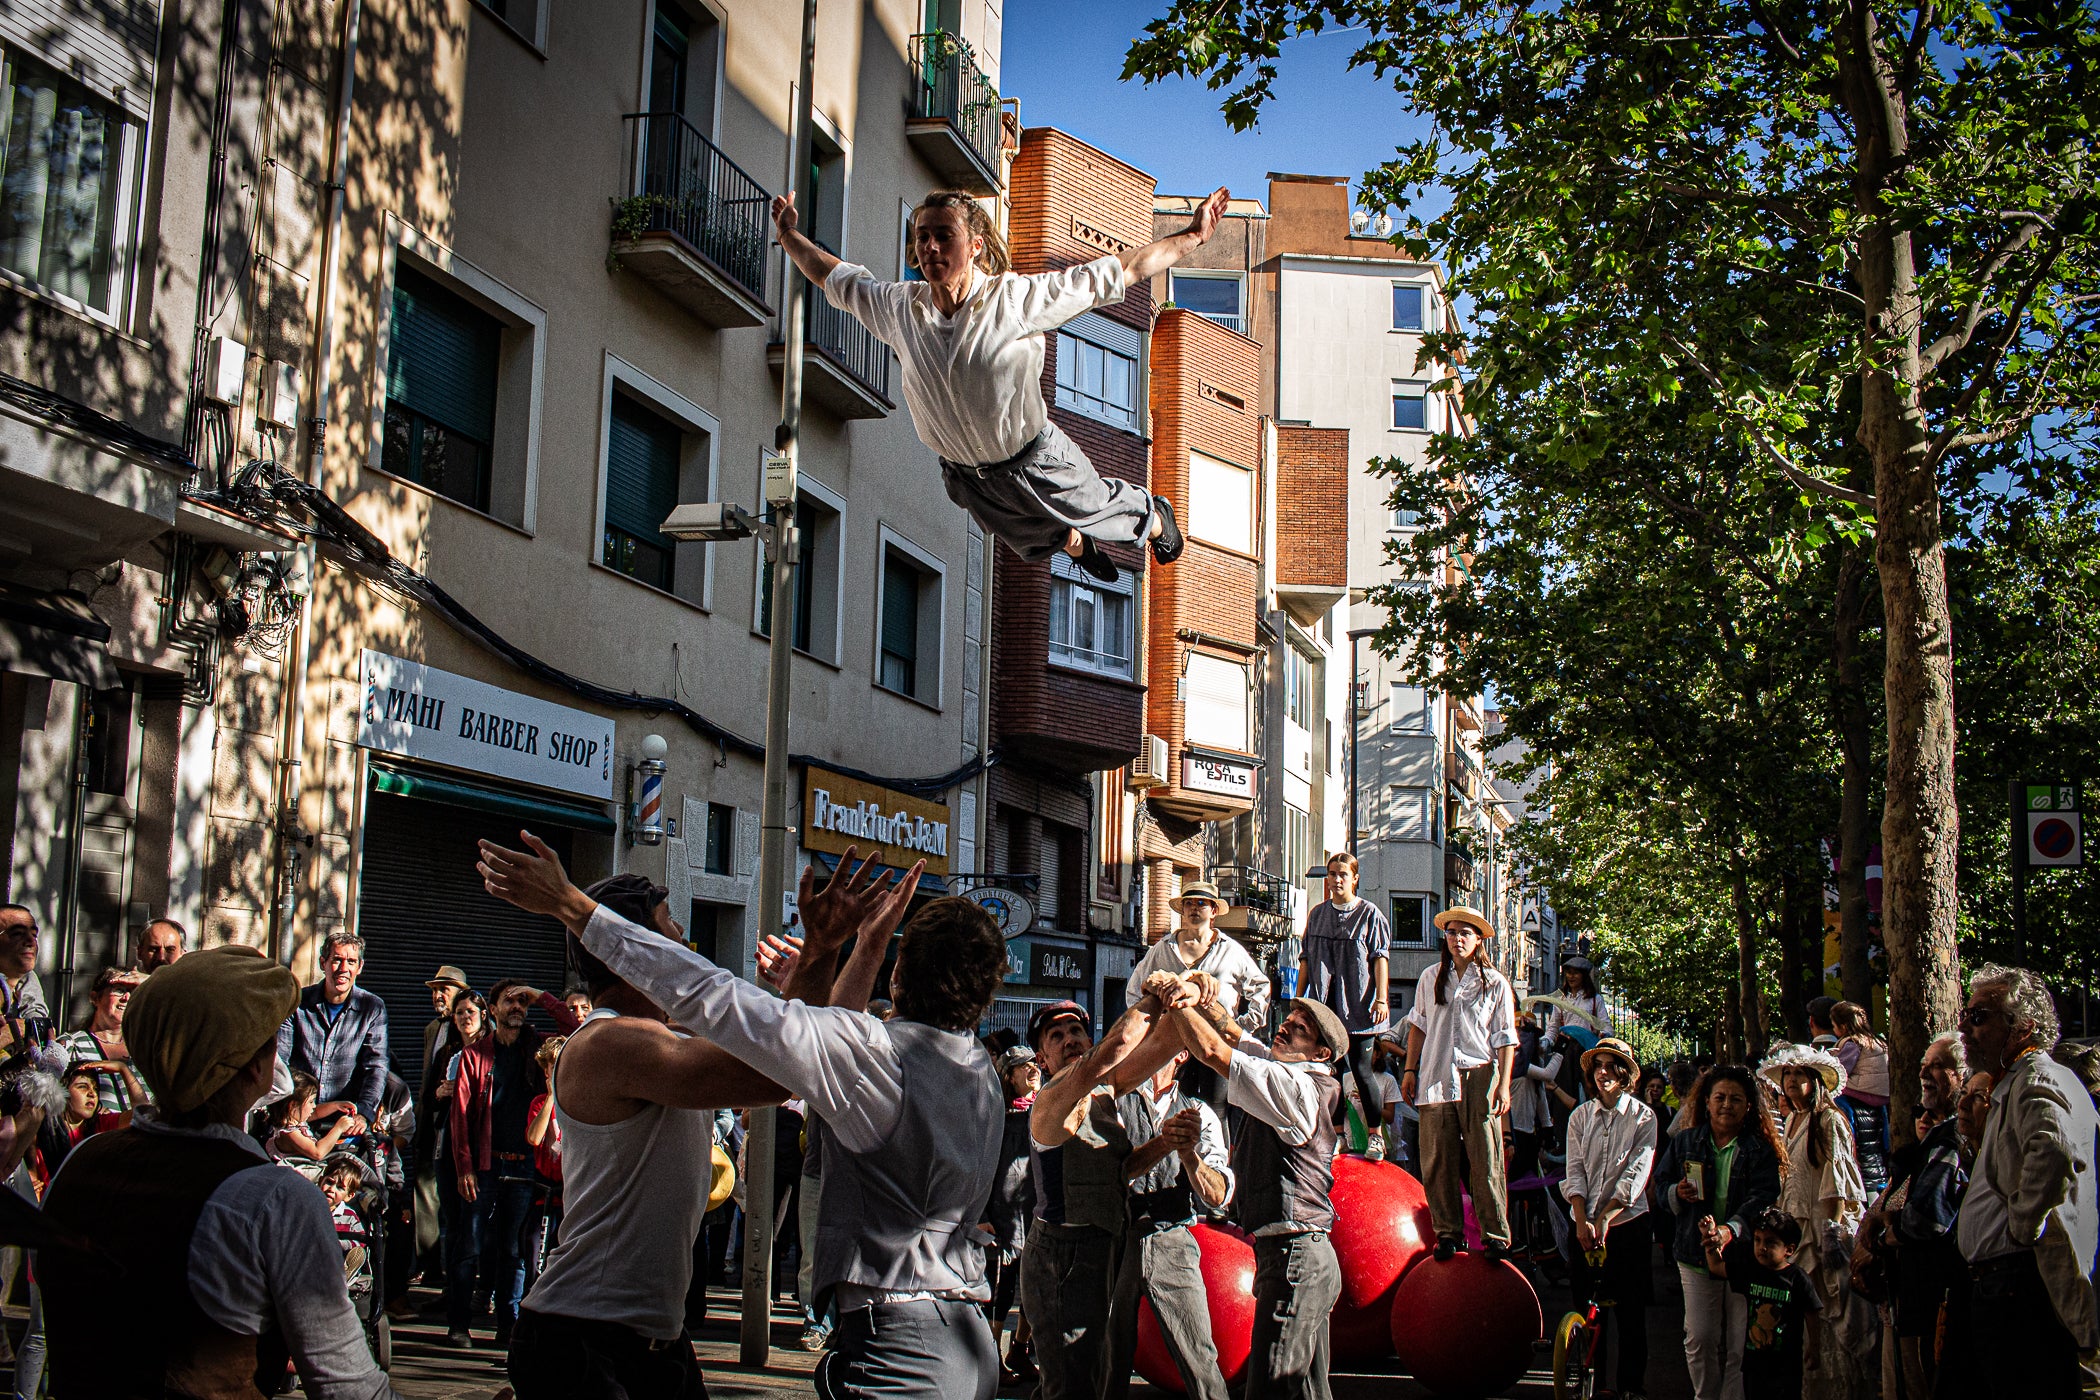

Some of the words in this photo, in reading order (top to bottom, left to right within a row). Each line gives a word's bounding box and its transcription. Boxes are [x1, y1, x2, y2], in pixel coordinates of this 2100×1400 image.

[385, 687, 445, 731] MAHI
[458, 707, 539, 755] BARBER
[548, 731, 598, 767] SHOP
[1195, 760, 1231, 779] ROSA
[1207, 764, 1246, 785] ESTILS
[812, 788, 913, 848] Frankfurt's
[914, 815, 948, 856] J&M
